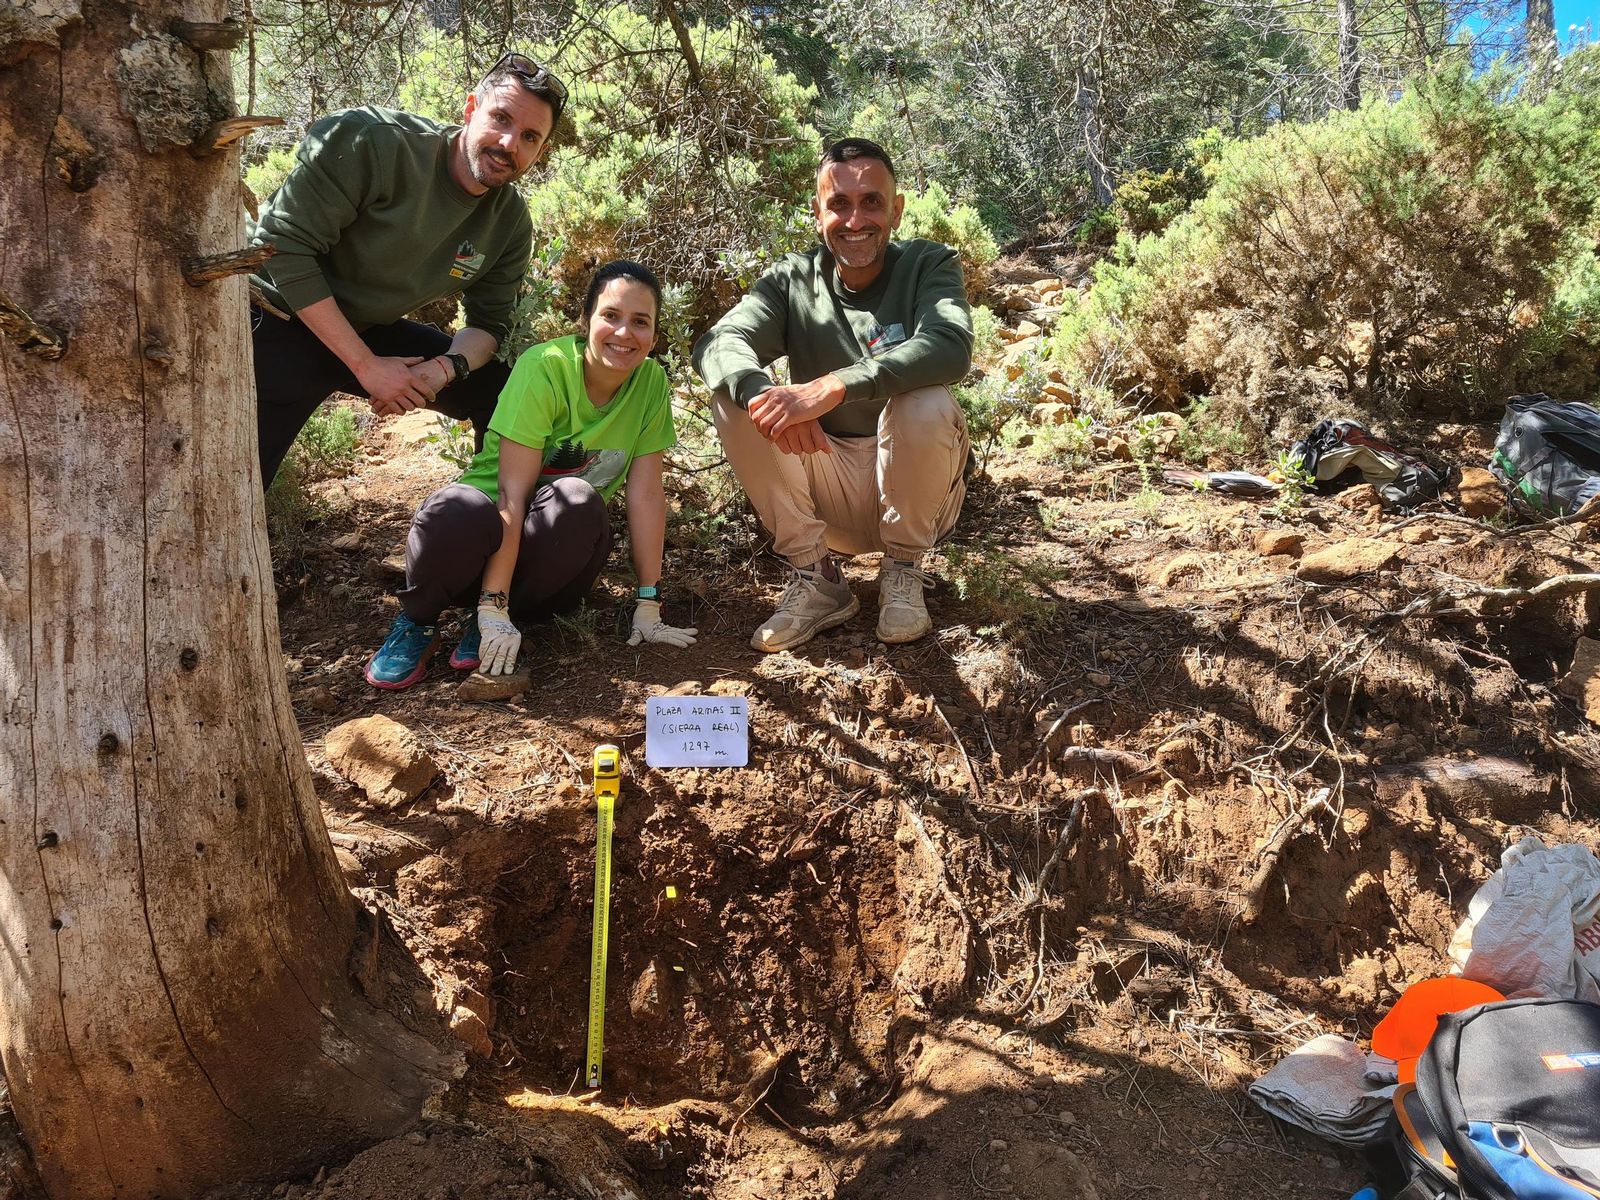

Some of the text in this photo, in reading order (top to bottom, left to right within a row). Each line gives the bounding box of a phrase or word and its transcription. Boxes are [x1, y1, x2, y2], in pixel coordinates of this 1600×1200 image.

[656, 706, 741, 716] PLAZA ARMAS II
[662, 722, 740, 734] (SIERRA REAL)
[682, 741, 710, 752] 1297
